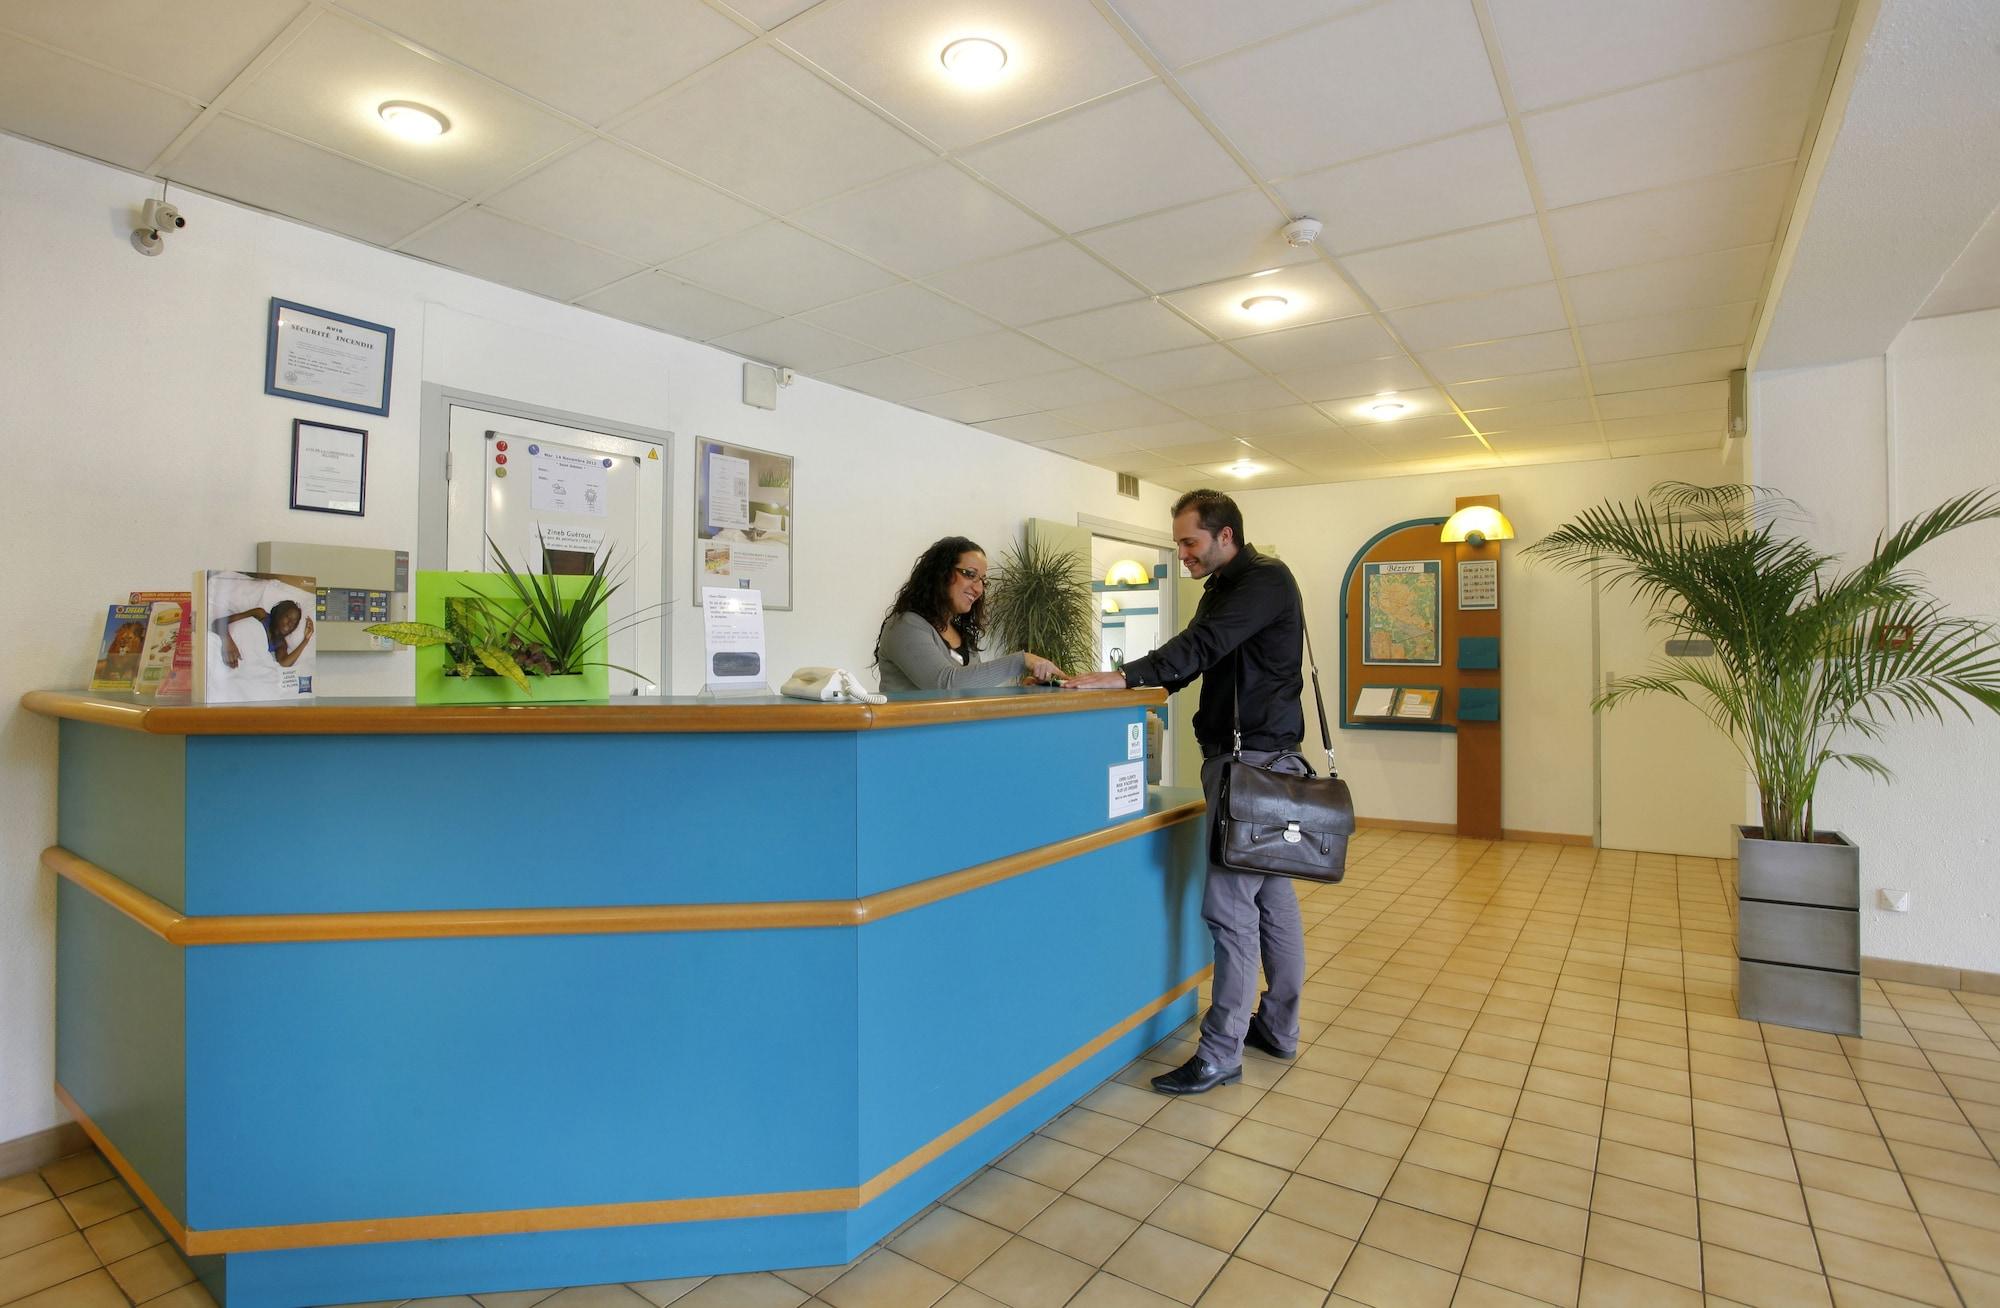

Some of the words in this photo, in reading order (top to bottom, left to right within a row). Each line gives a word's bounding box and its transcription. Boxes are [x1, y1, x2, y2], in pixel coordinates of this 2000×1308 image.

[336, 335, 374, 350] INCENDIE
[547, 528, 565, 537] Zineb
[567, 531, 592, 539] Guérout
[1386, 564, 1416, 573] Béziers
